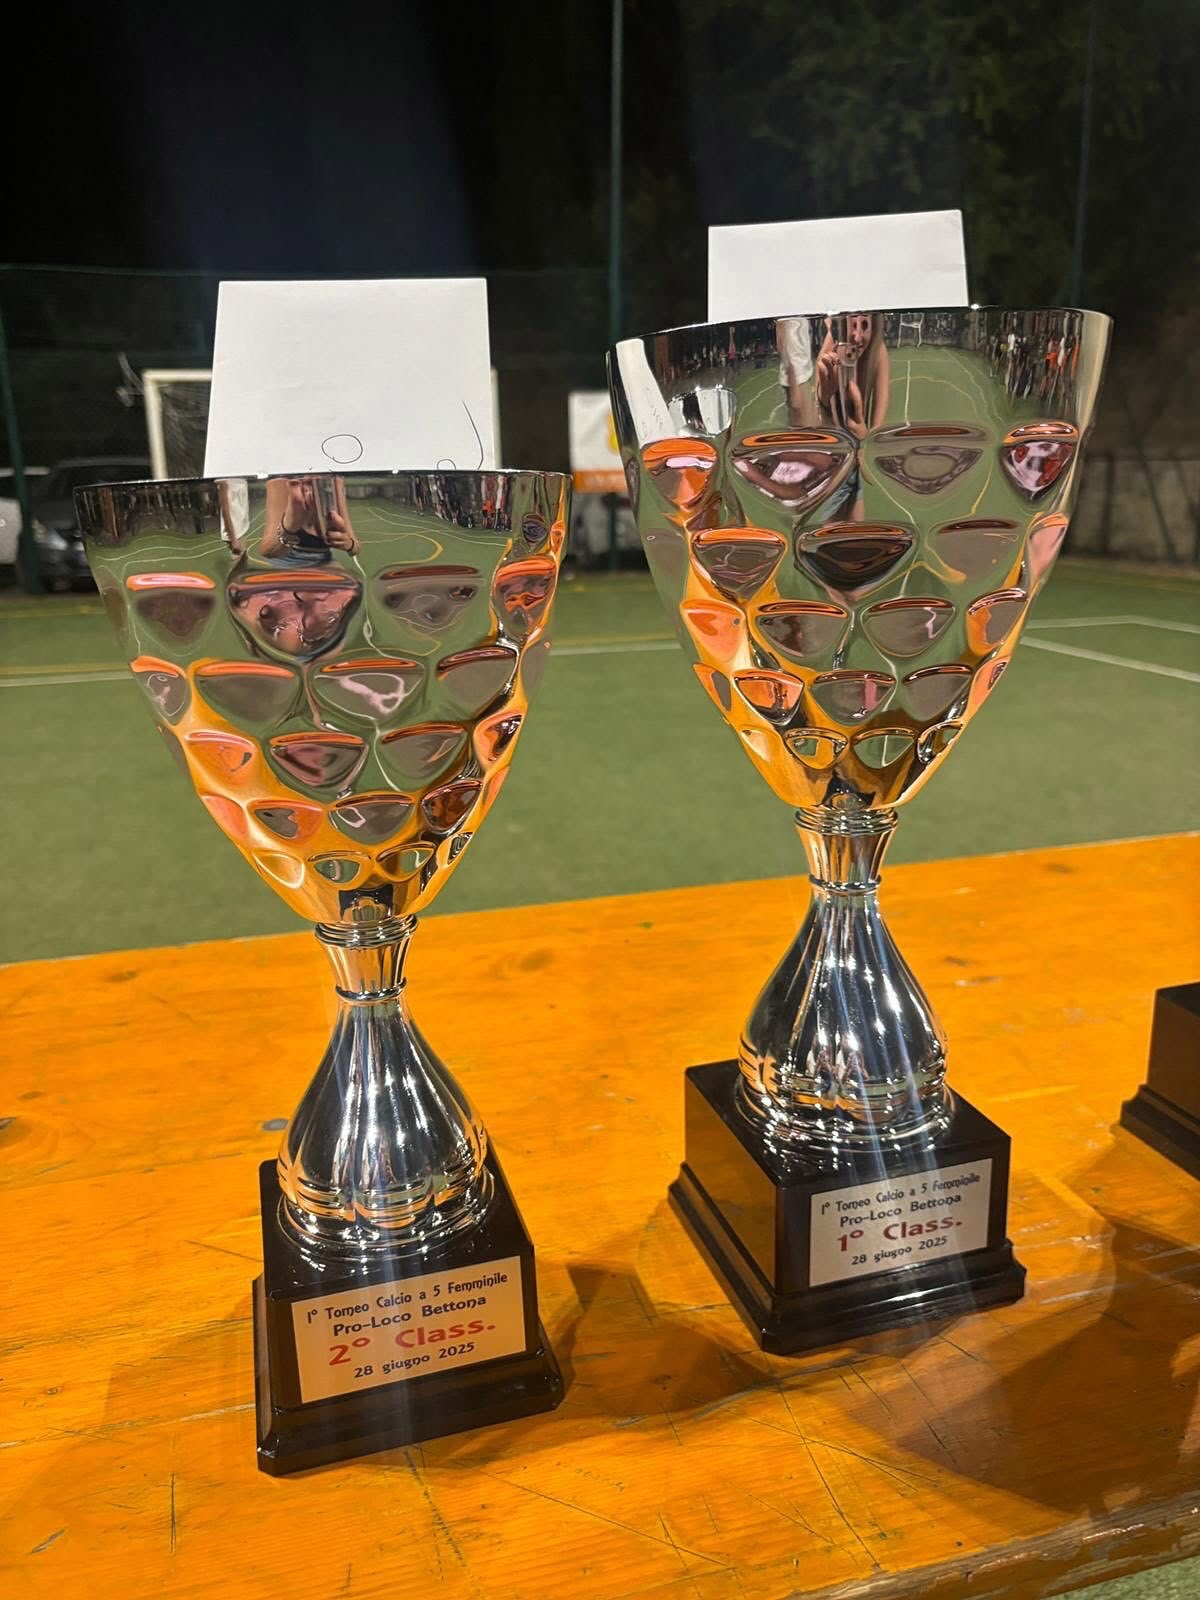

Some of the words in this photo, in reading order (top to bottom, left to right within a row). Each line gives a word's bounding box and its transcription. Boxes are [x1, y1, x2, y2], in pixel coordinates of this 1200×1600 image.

[836, 1198, 870, 1213] Torneo
[876, 1190, 904, 1203] Calcio
[921, 1183, 927, 1193] 5
[932, 1173, 980, 1192] Femminile
[840, 1208, 902, 1227] Pro-Loco
[910, 1195, 961, 1212] Bettona
[837, 1230, 864, 1251] 1°
[883, 1216, 962, 1240] Class.
[852, 1255, 866, 1265] 28
[874, 1246, 912, 1262] giugno
[919, 1236, 947, 1250] 2025
[326, 1304, 369, 1320] Torneo
[377, 1291, 412, 1307] Calcio
[419, 1291, 426, 1300] a
[434, 1285, 440, 1296] 5
[448, 1273, 508, 1294] Femminile
[333, 1313, 411, 1336] Pro-Loco
[422, 1296, 487, 1318] Bettona
[329, 1338, 371, 1365] 2°
[395, 1319, 495, 1348] Class.
[354, 1365, 373, 1378] 28
[382, 1355, 430, 1374] giugno
[440, 1342, 474, 1359] 2025
